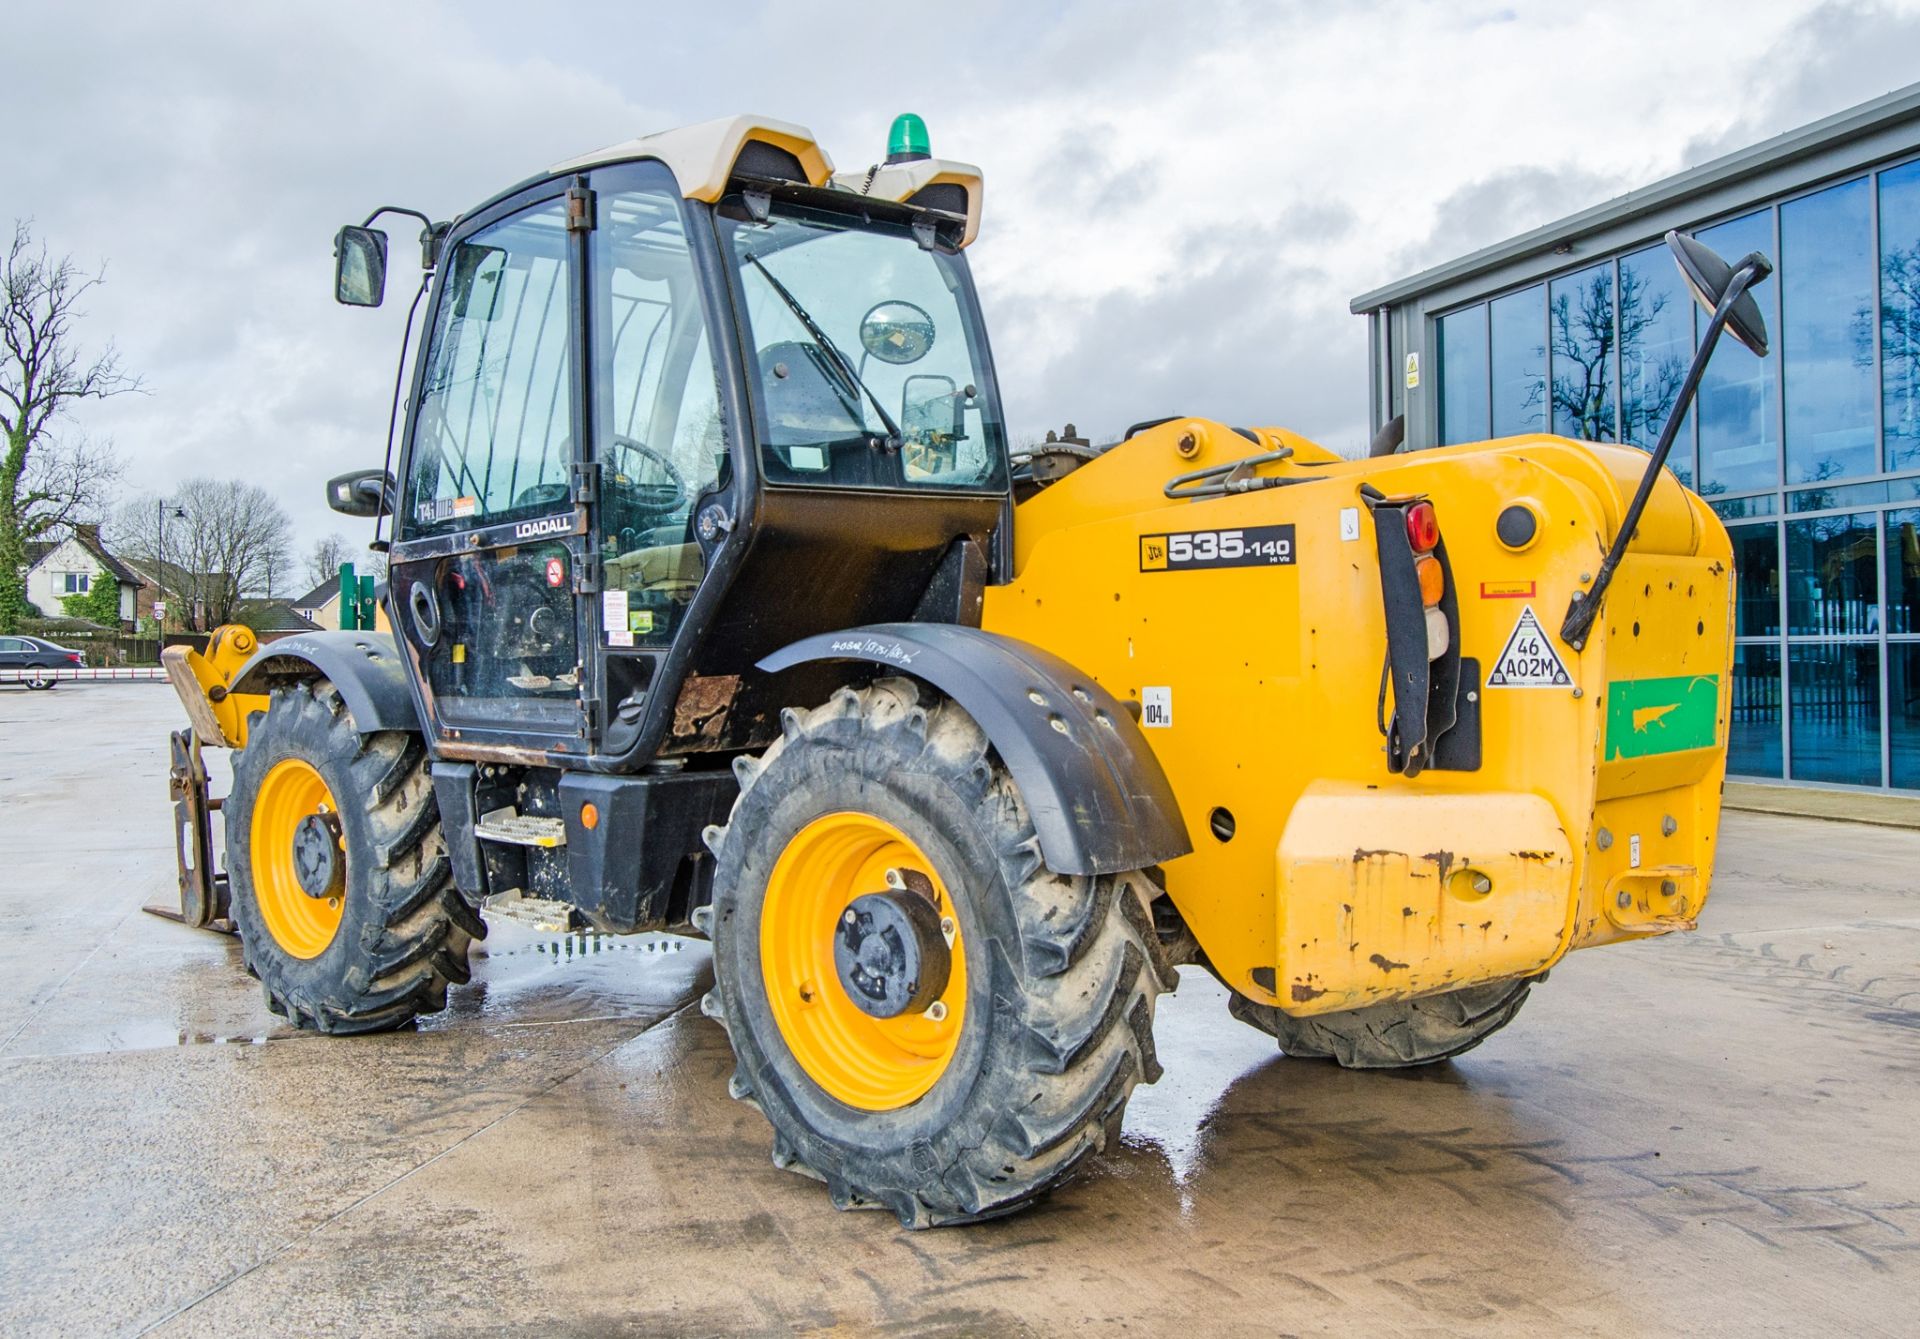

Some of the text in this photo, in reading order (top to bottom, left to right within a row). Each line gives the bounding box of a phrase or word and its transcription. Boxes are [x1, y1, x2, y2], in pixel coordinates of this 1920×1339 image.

[515, 517, 572, 538] LOADALL
[1148, 545, 1163, 561] JCB
[1168, 530, 1290, 562] 535-140
[1517, 637, 1539, 656] 46
[1505, 658, 1554, 677] A02M
[1145, 704, 1162, 724] 104
